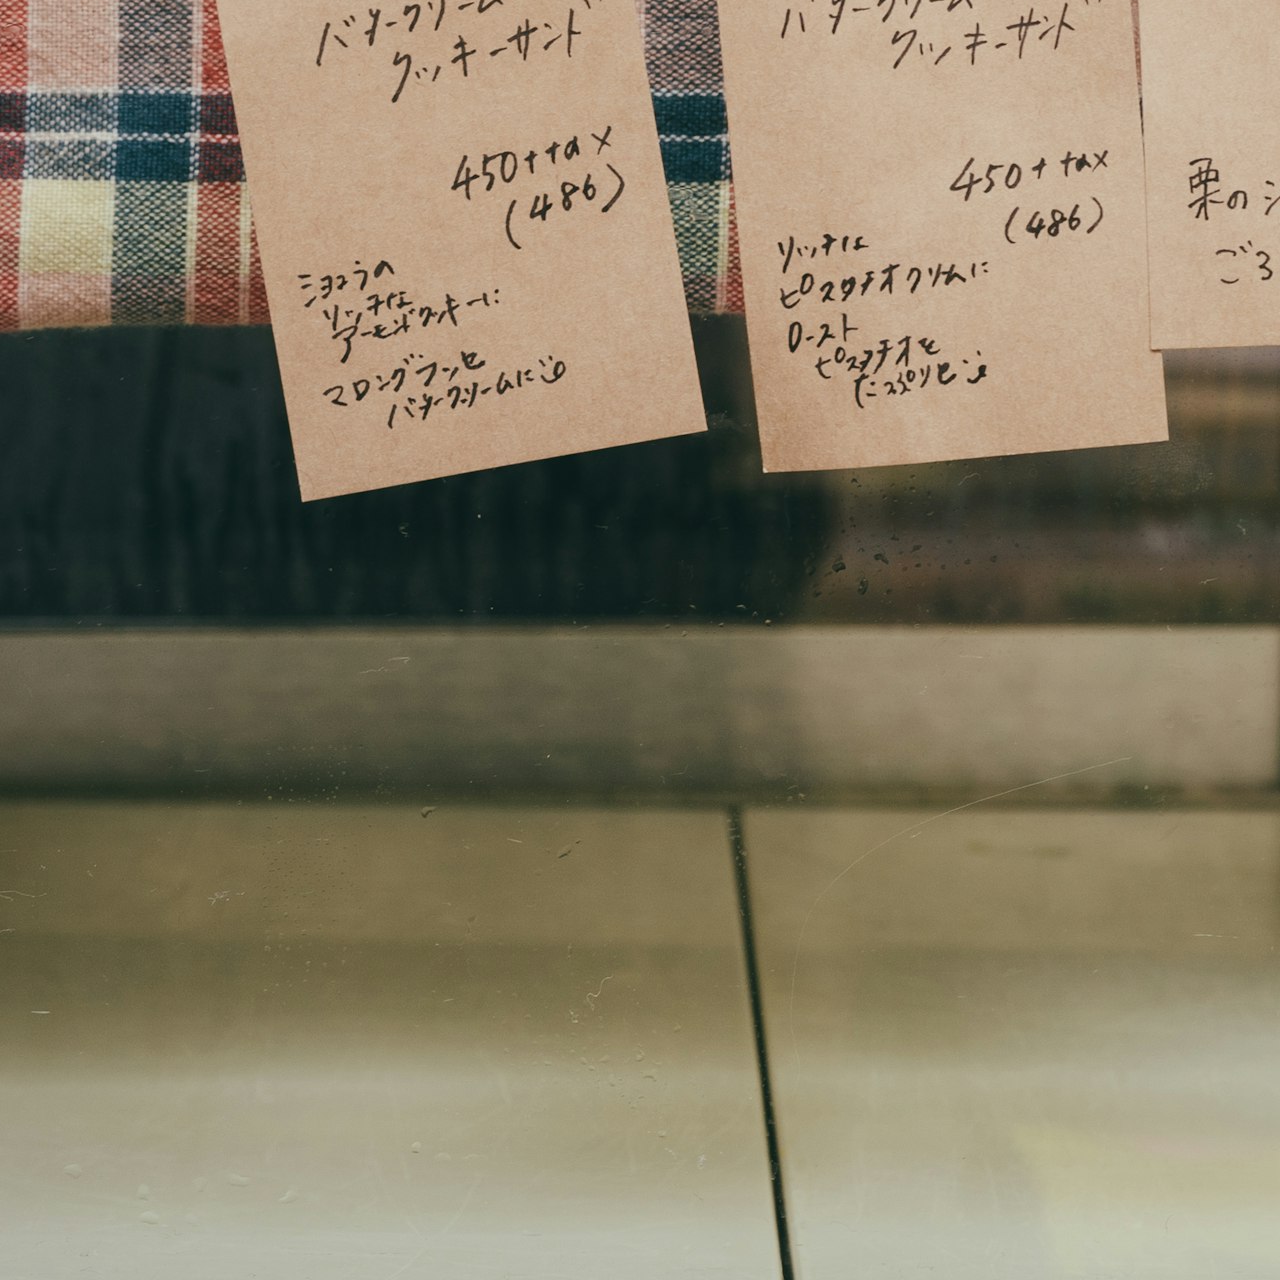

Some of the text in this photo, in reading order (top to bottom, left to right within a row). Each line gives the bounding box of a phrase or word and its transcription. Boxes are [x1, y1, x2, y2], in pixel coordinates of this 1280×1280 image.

[505, 163, 626, 250] (486)
[1005, 196, 1104, 244] (486)
[297, 260, 395, 308] ショコラの
[788, 312, 859, 354] ロースト
[322, 350, 486, 407] マロングラッセ
